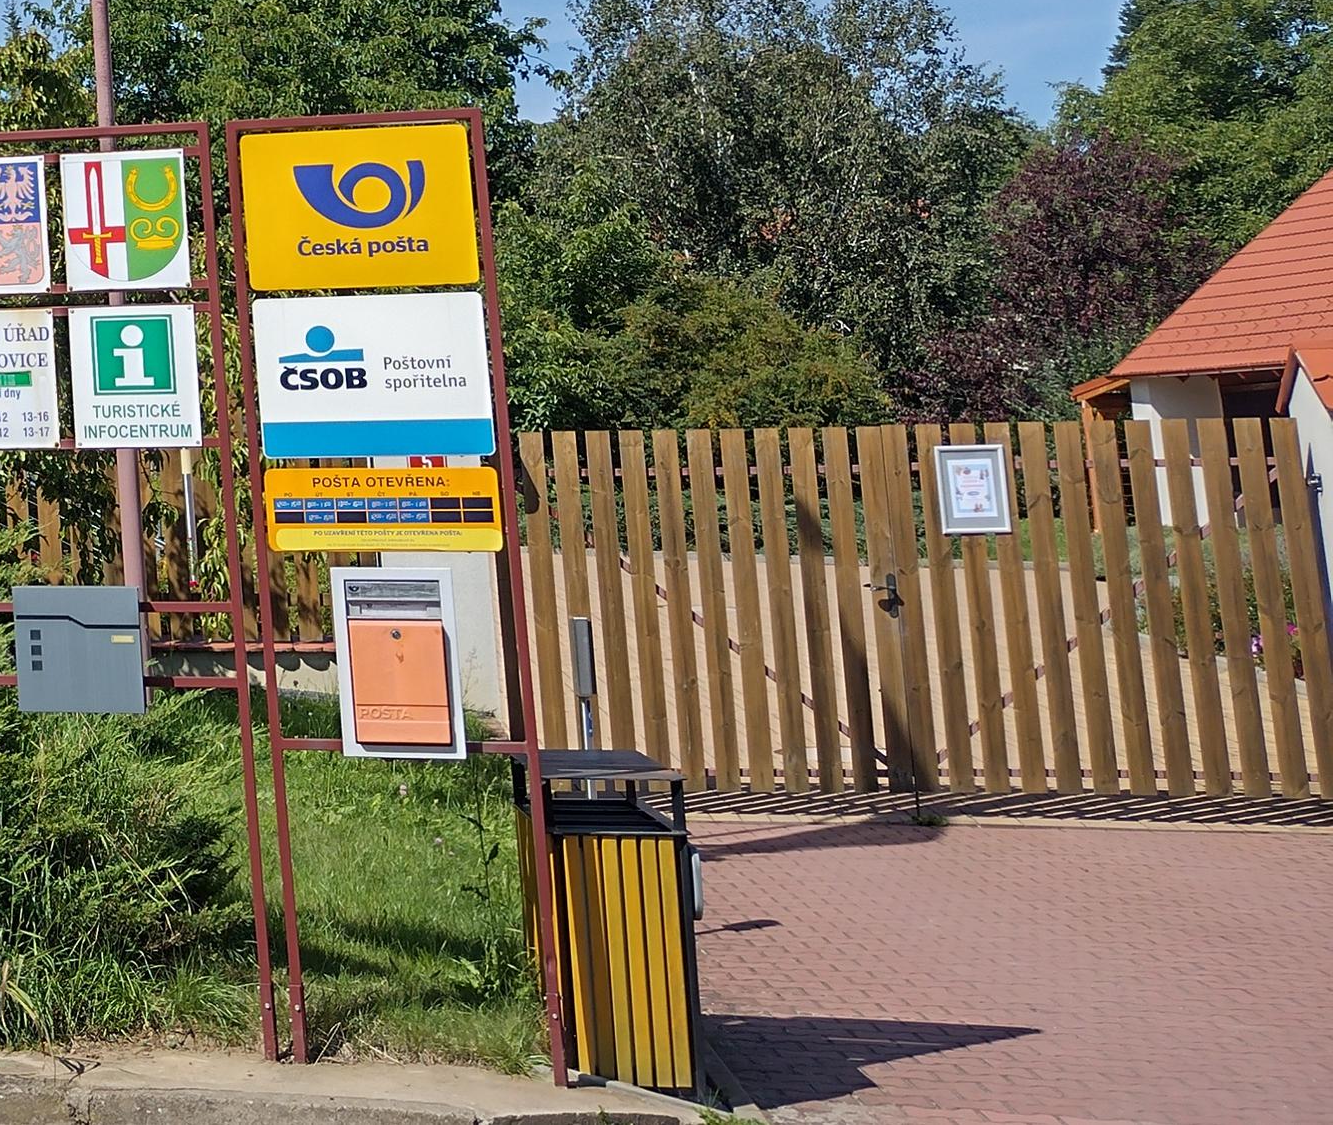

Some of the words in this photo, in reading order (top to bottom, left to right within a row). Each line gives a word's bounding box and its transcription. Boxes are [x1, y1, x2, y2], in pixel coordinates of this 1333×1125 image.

[297, 236, 362, 256] Česká
[368, 236, 429, 257] pošta
[3, 323, 50, 342] ÚŘAD
[383, 355, 451, 370] Poštovní
[279, 365, 368, 391] ČSOB
[385, 375, 467, 392] spořitelna
[4, 388, 21, 400] dny
[23, 411, 49, 422] 13-16
[93, 401, 181, 419] TURISTICKÉ
[23, 426, 50, 437] 13-17
[84, 423, 193, 439] INFOCENTRUM
[312, 475, 361, 488] POŠTA
[366, 474, 451, 488] OTEVŘENA:
